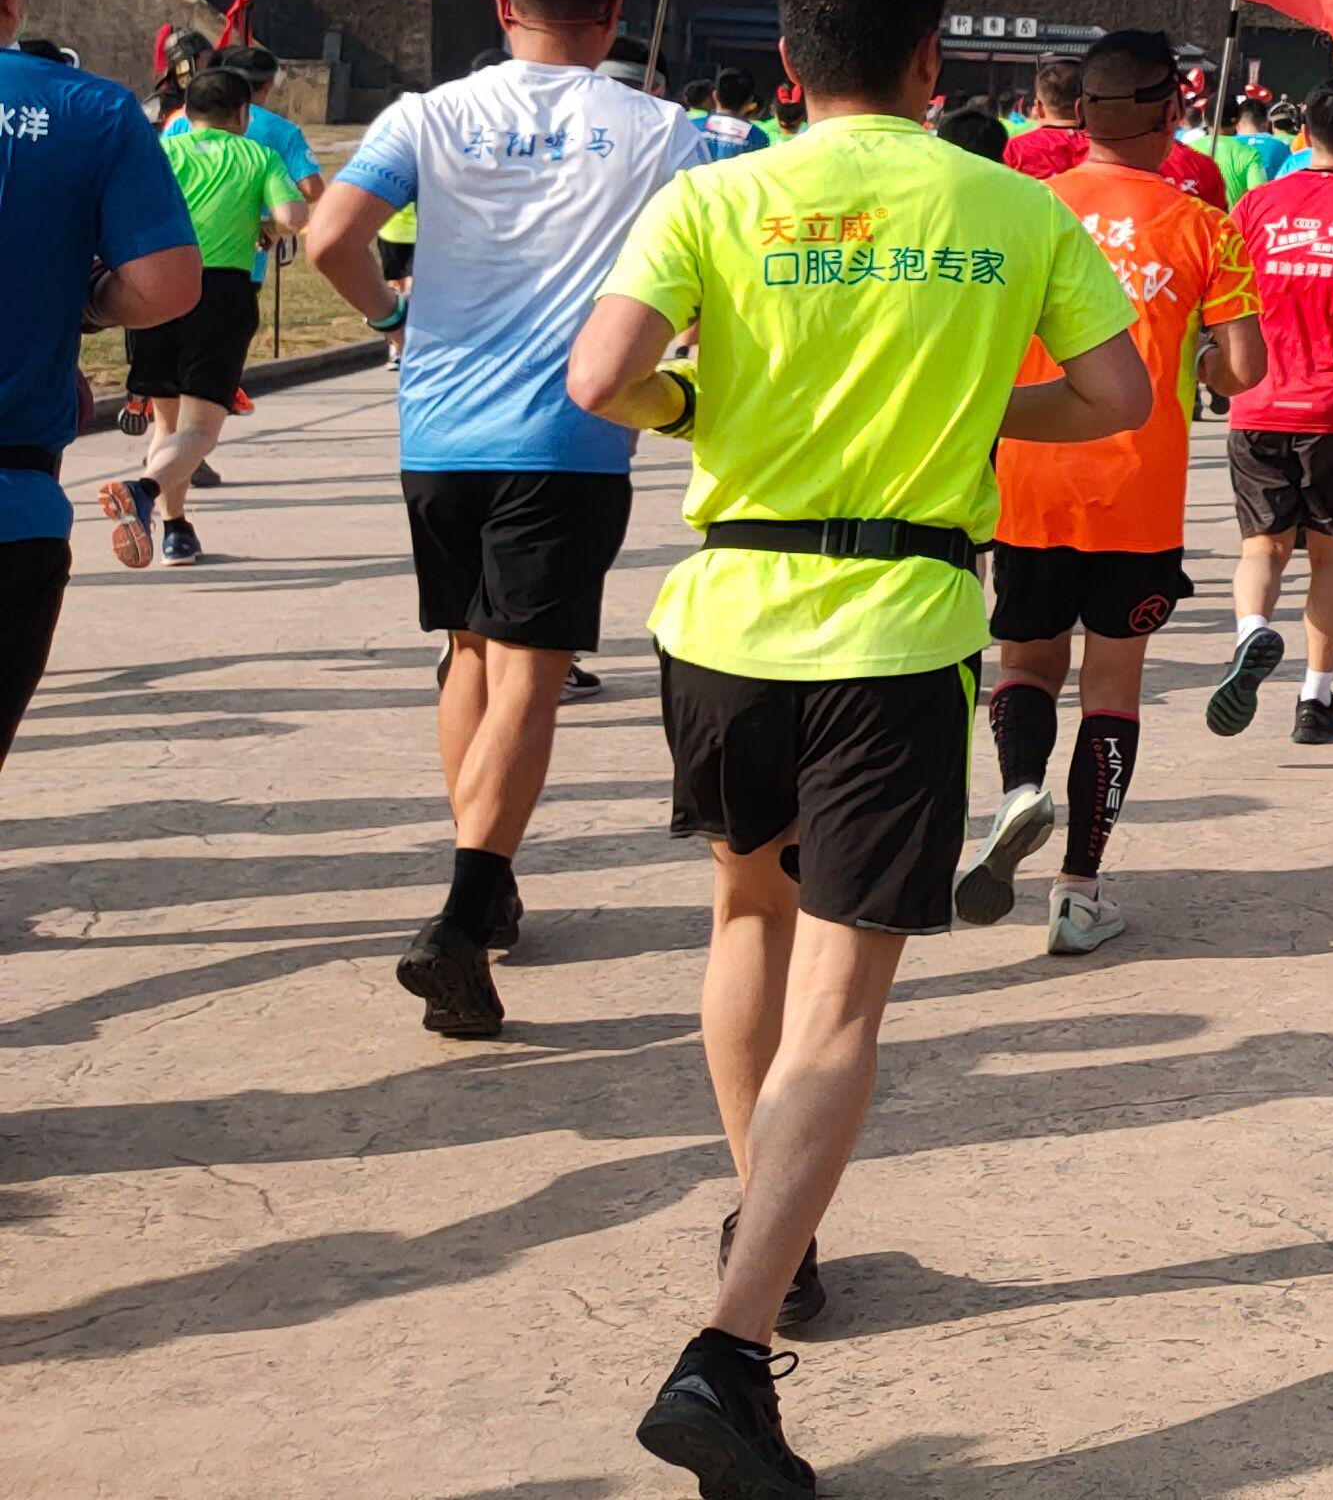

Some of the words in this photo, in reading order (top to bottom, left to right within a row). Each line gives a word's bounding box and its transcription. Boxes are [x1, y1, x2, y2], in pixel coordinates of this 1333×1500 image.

[761, 212, 875, 246] 天立威
[764, 246, 1007, 286] 口服头孢专家
